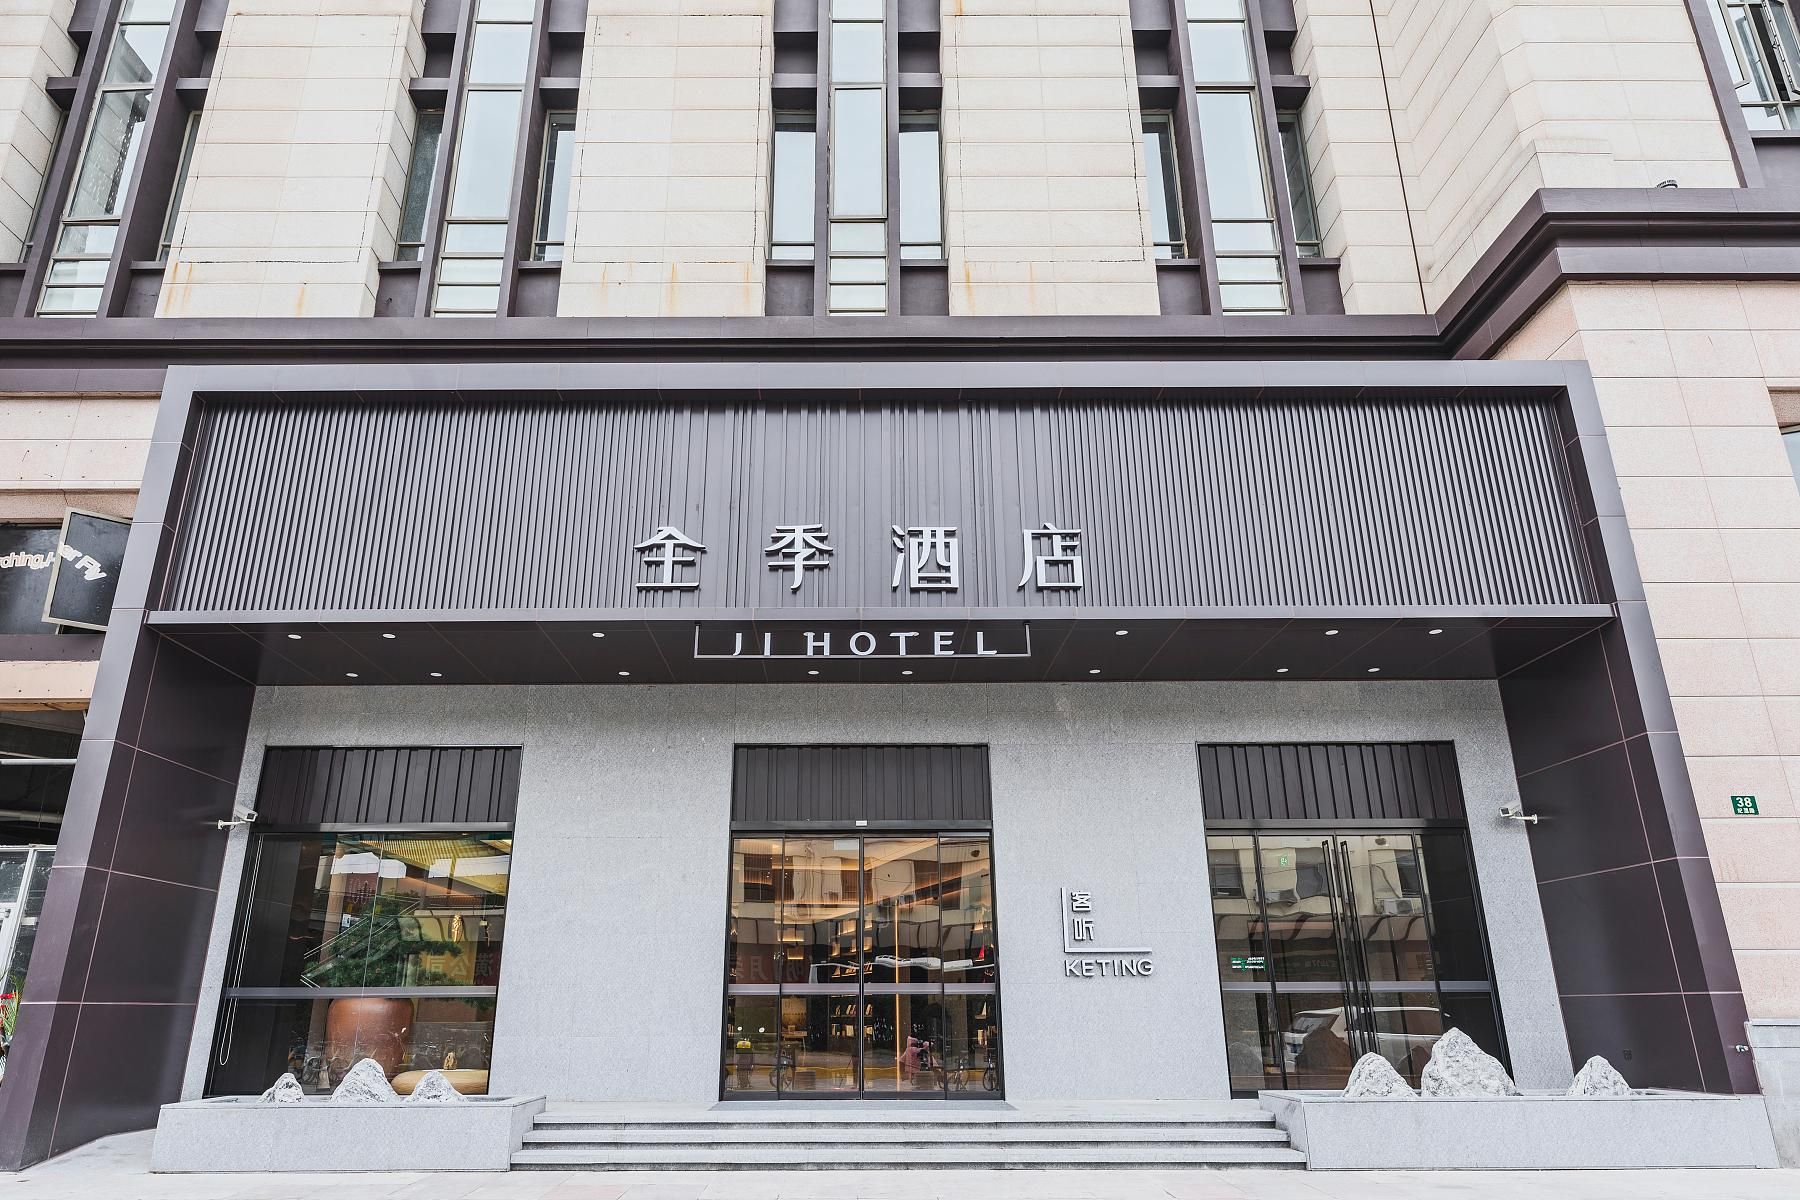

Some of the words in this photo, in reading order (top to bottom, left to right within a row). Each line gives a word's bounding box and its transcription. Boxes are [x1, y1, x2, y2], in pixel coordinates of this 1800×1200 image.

[633, 522, 1083, 593] 全季酒店
[732, 631, 771, 656] JI
[807, 631, 998, 656] HOTEL
[1735, 796, 1753, 808] 38
[1064, 959, 1154, 977] KETING
